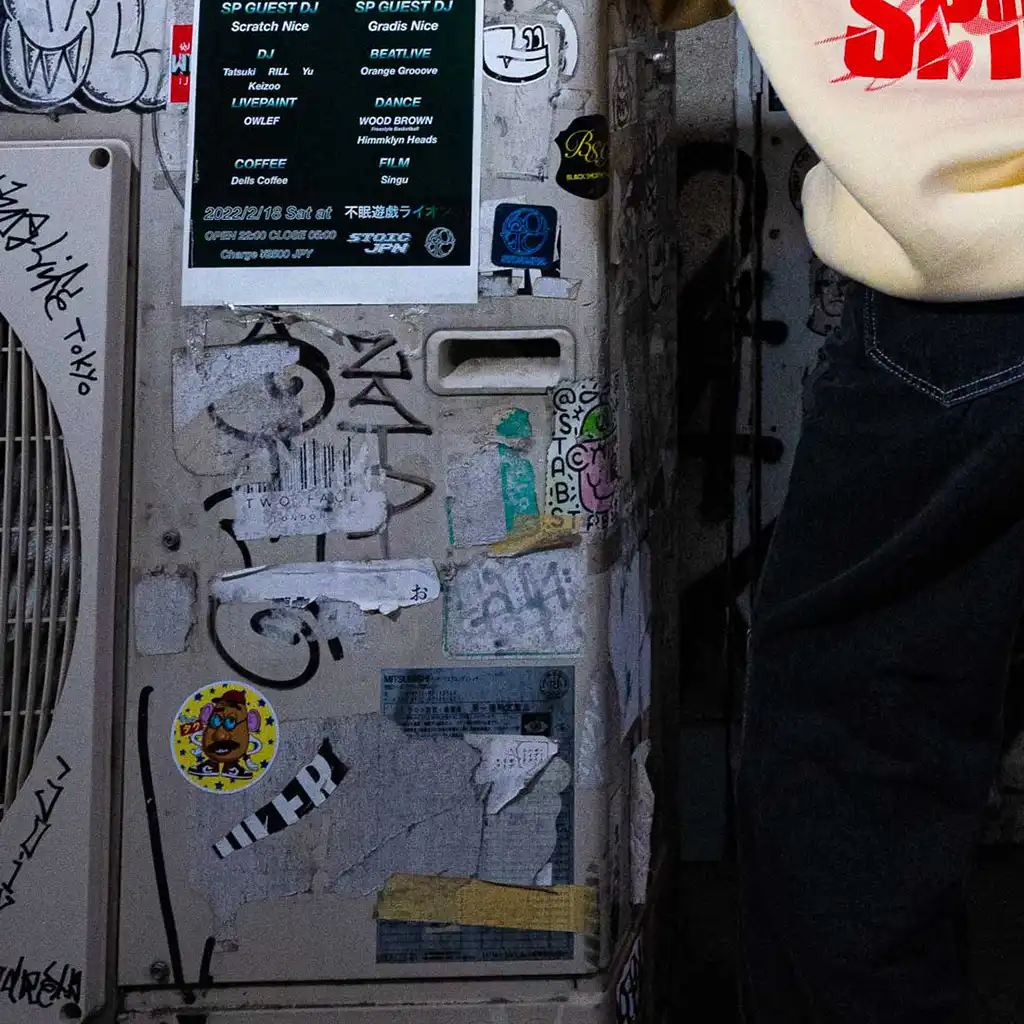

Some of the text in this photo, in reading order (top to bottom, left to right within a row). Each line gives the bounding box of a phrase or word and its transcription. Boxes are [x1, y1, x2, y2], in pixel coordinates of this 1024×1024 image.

[220, 2, 320, 15] SP GUEST DJ
[354, 0, 453, 13] SP GUEST DJ
[231, 21, 309, 32] Scratch Nice
[368, 20, 439, 31] Gradis Nice
[256, 49, 275, 60] DJ
[370, 48, 431, 59] BEATLIVE
[223, 67, 314, 76] Tatsuki RILL Yu
[360, 66, 395, 78] Orange
[248, 81, 281, 91] Keizoo
[231, 97, 298, 109] LIVEPAINT
[375, 97, 422, 108] DANCE
[243, 116, 281, 126] OWLEF
[359, 116, 434, 126] WOOD BROWN
[407, 135, 438, 144] Heads
[234, 159, 288, 170] COFFEE
[379, 158, 410, 168] FILM
[231, 176, 288, 186] Dells Coffee
[380, 175, 409, 187] Singu
[203, 205, 333, 221] 2022/2/18 Sat at
[204, 230, 238, 241] OPEN
[268, 230, 306, 241] CLOSE
[347, 232, 412, 243] STOIC
[364, 243, 410, 255] JPN
[220, 249, 258, 261] Charge
[291, 249, 315, 259] JPY
[246, 496, 290, 509] TWO
[410, 584, 428, 601] お
[384, 674, 430, 683] MITSUSHI
